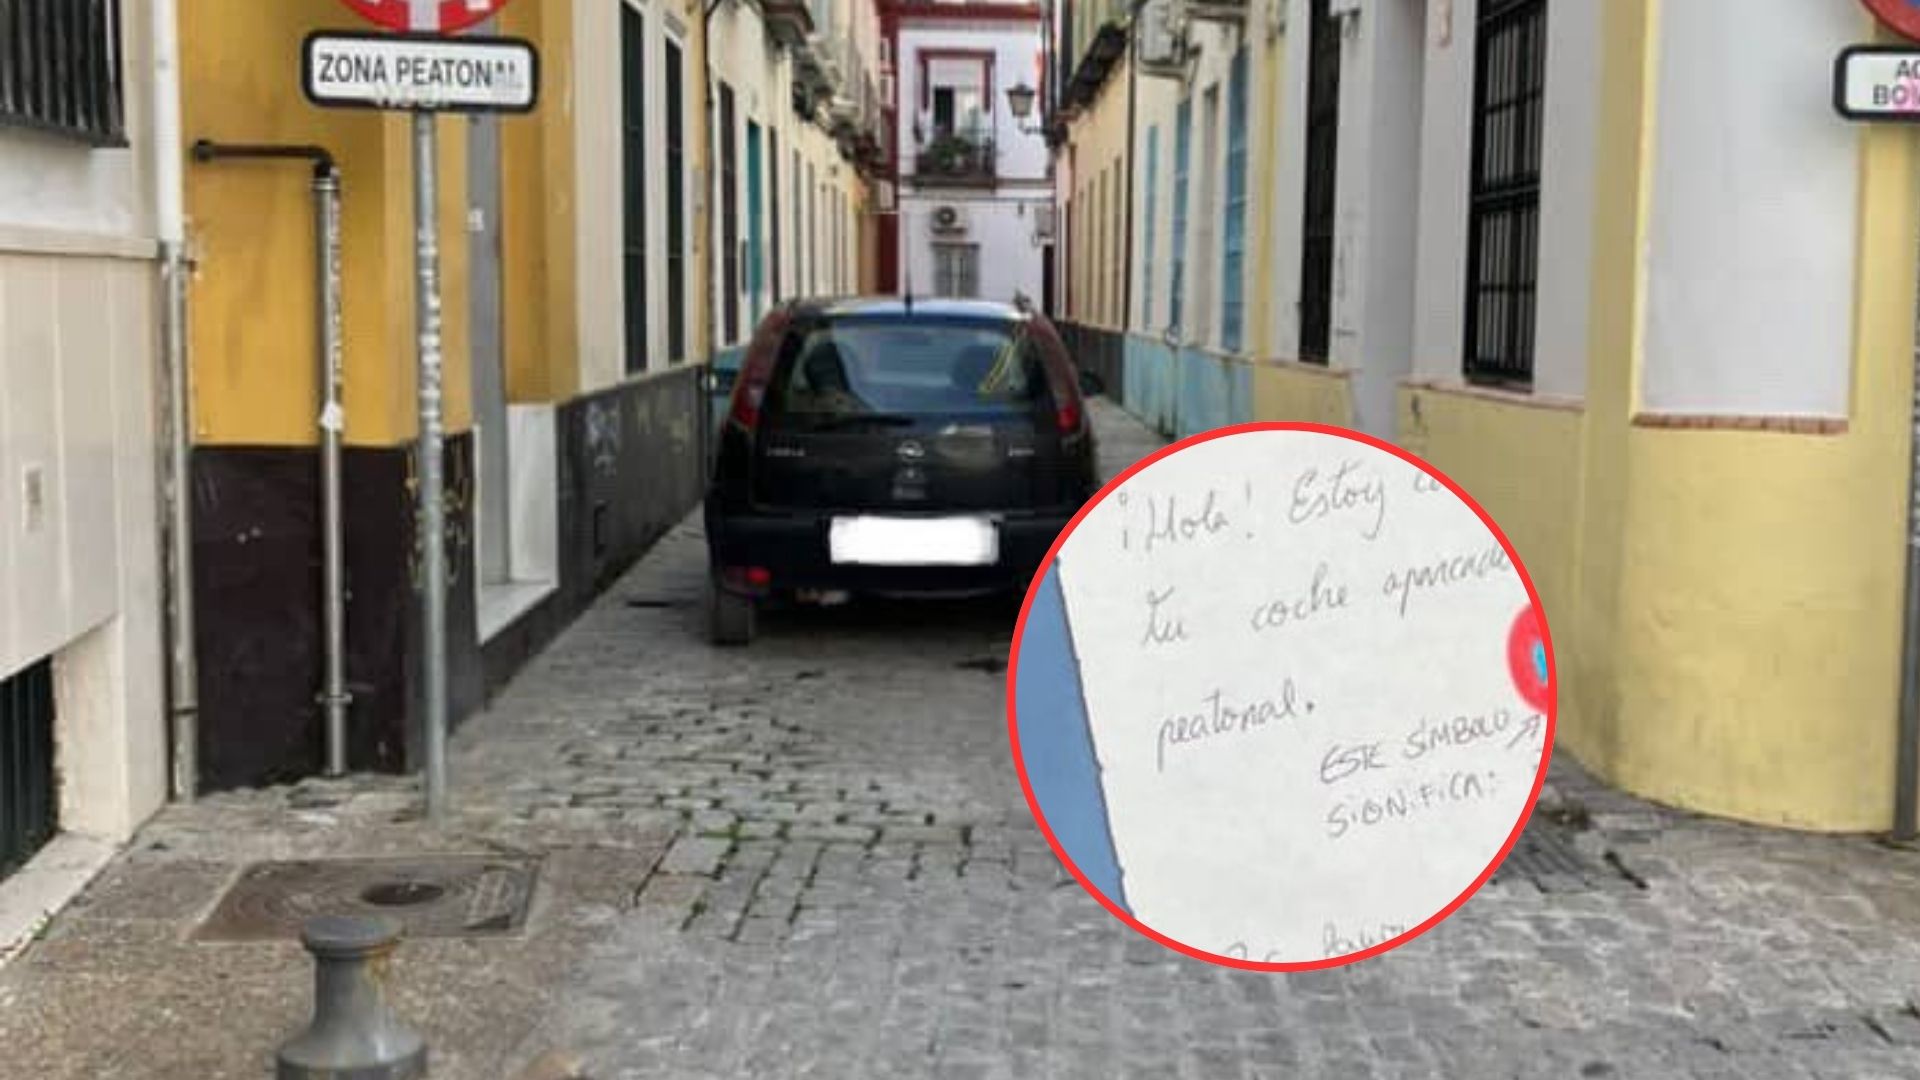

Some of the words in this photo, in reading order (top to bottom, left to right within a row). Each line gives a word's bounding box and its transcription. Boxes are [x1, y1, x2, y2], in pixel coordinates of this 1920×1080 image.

[318, 53, 387, 83] ZONA
[1288, 459, 1384, 540] Estoy
[1251, 563, 1349, 632] coche
[1320, 742, 1387, 784] ESTE
